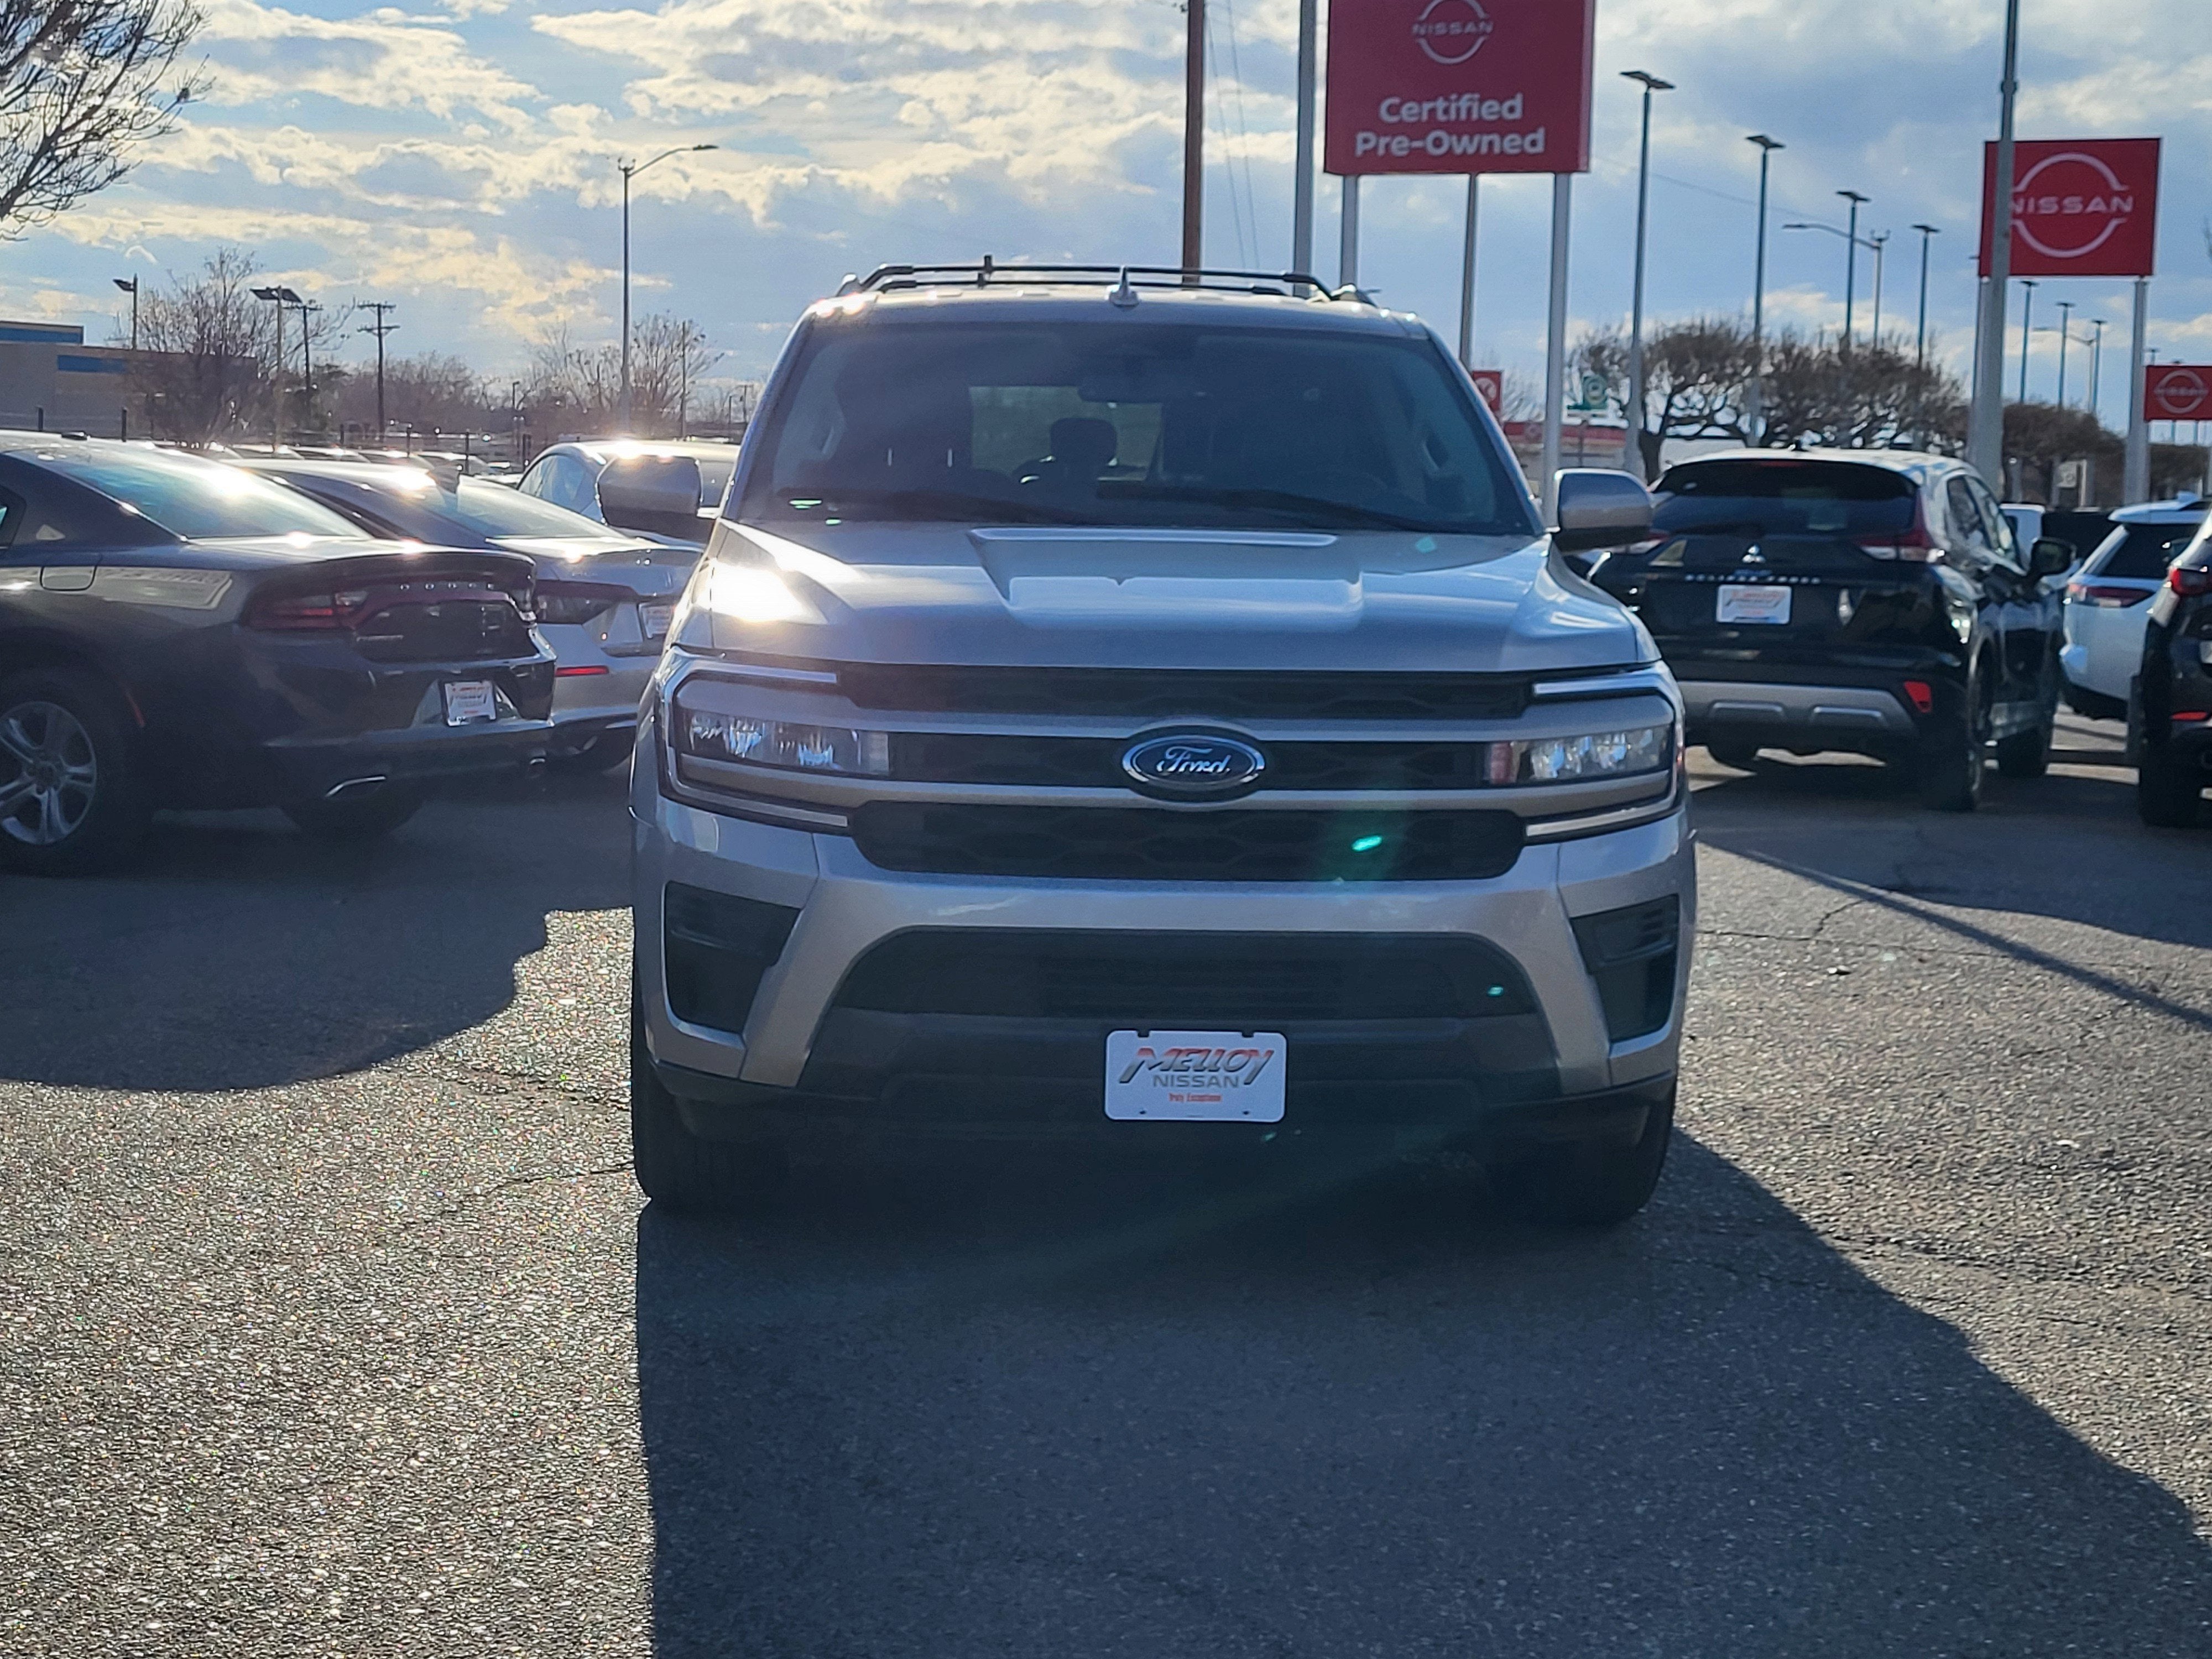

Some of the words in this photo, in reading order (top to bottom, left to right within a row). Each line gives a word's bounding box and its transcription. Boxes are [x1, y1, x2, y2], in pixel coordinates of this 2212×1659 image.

[1412, 21, 1494, 36] NISSAN
[1379, 92, 1523, 123] Certified
[1355, 127, 1545, 157] Pre-Owned
[2011, 196, 2133, 214] NISSAN
[1156, 747, 1232, 773] Ford
[1152, 1075, 1239, 1088] NISSAN
